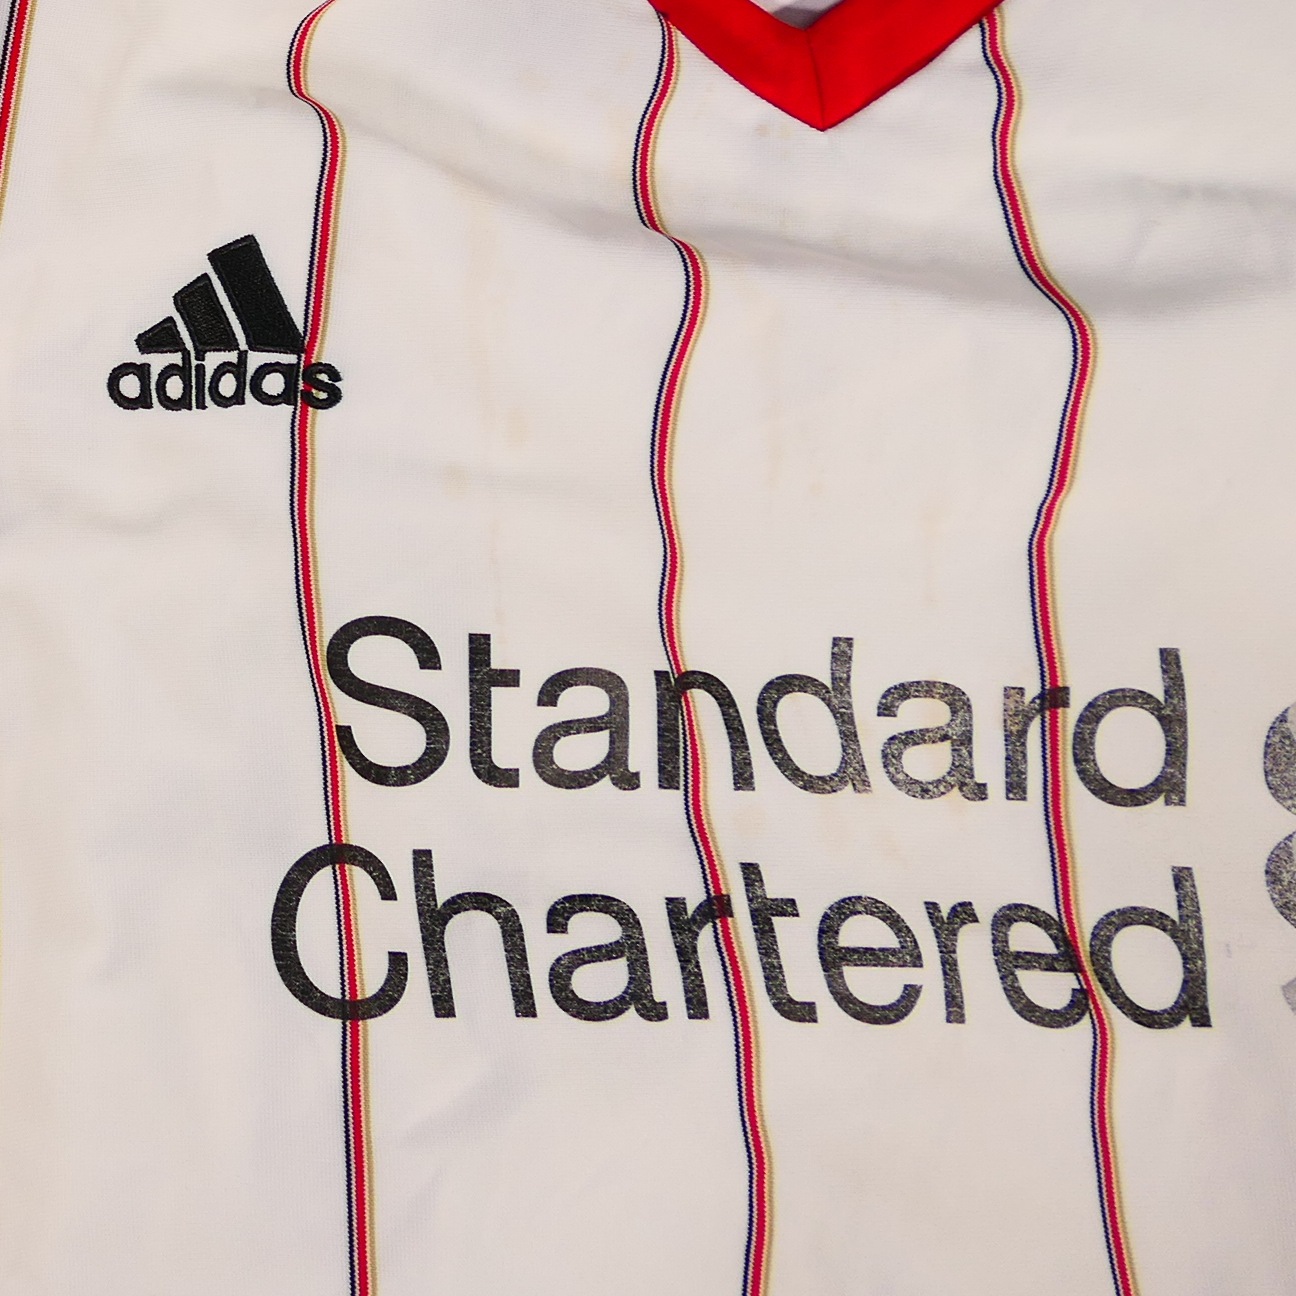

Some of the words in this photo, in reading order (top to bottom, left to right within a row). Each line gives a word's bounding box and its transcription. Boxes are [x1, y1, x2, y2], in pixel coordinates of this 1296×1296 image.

[107, 349, 343, 411] adidas
[325, 615, 1189, 808] Standard
[270, 842, 1212, 1029] Chartered
